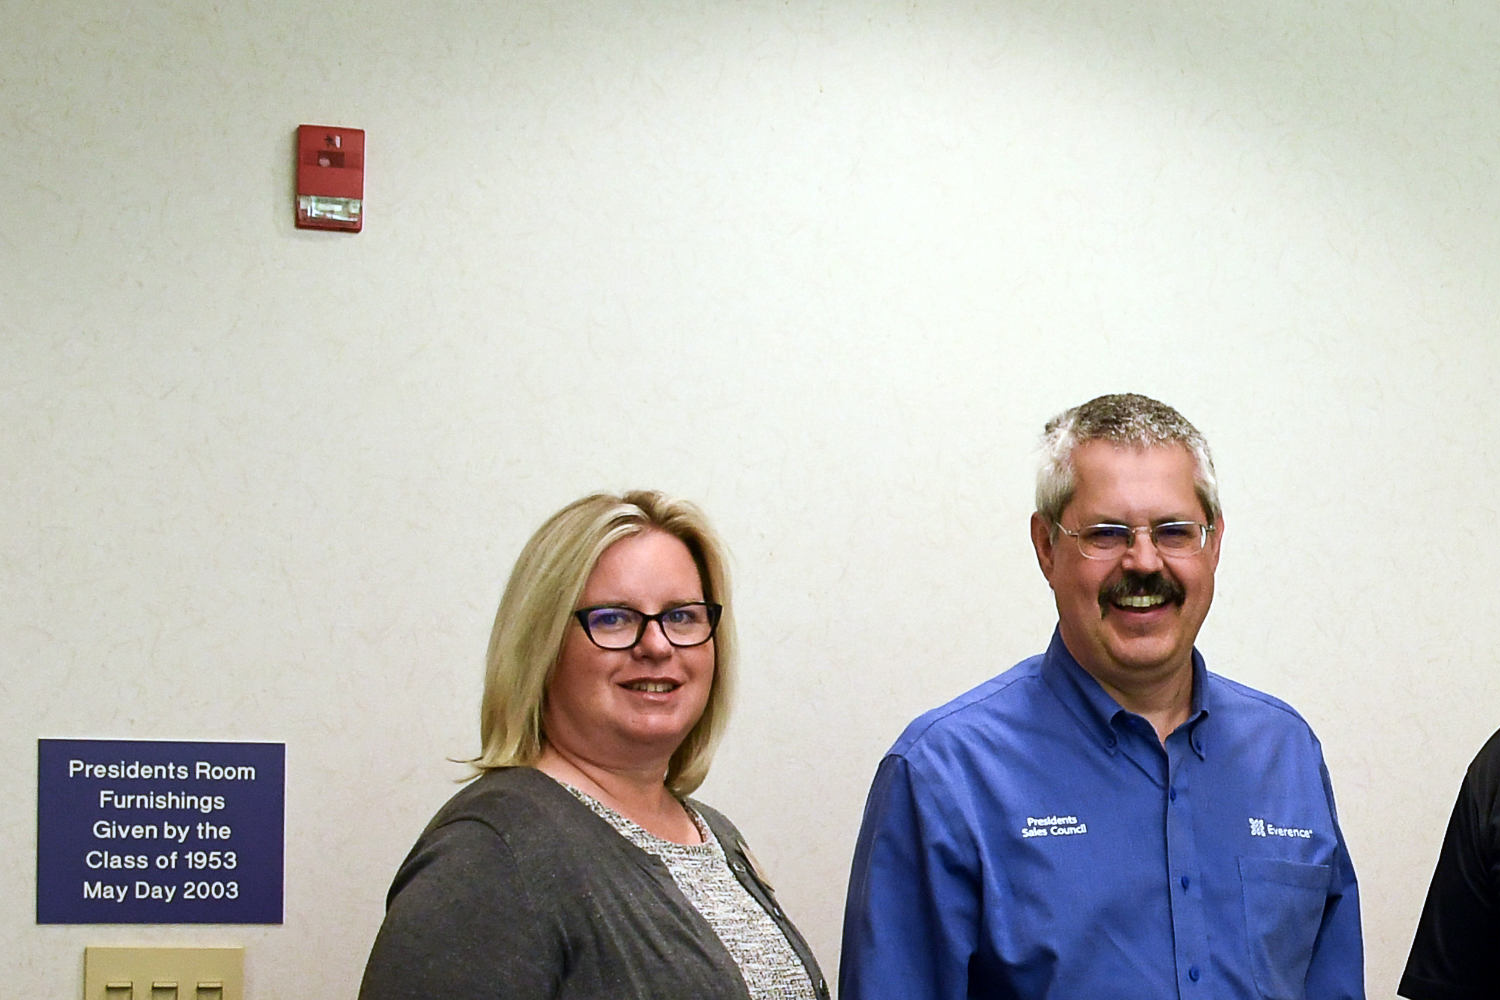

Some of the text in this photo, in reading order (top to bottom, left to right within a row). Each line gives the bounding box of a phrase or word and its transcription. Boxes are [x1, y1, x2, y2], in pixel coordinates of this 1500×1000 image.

[69, 760, 256, 780] Presidents Room
[100, 790, 226, 813] Furnishings
[1022, 823, 1087, 837] Sales Council
[1027, 815, 1077, 826] Presidents
[93, 821, 232, 843] Given by the
[85, 850, 238, 869] Class of 1953
[83, 881, 239, 902] May Day 2003
